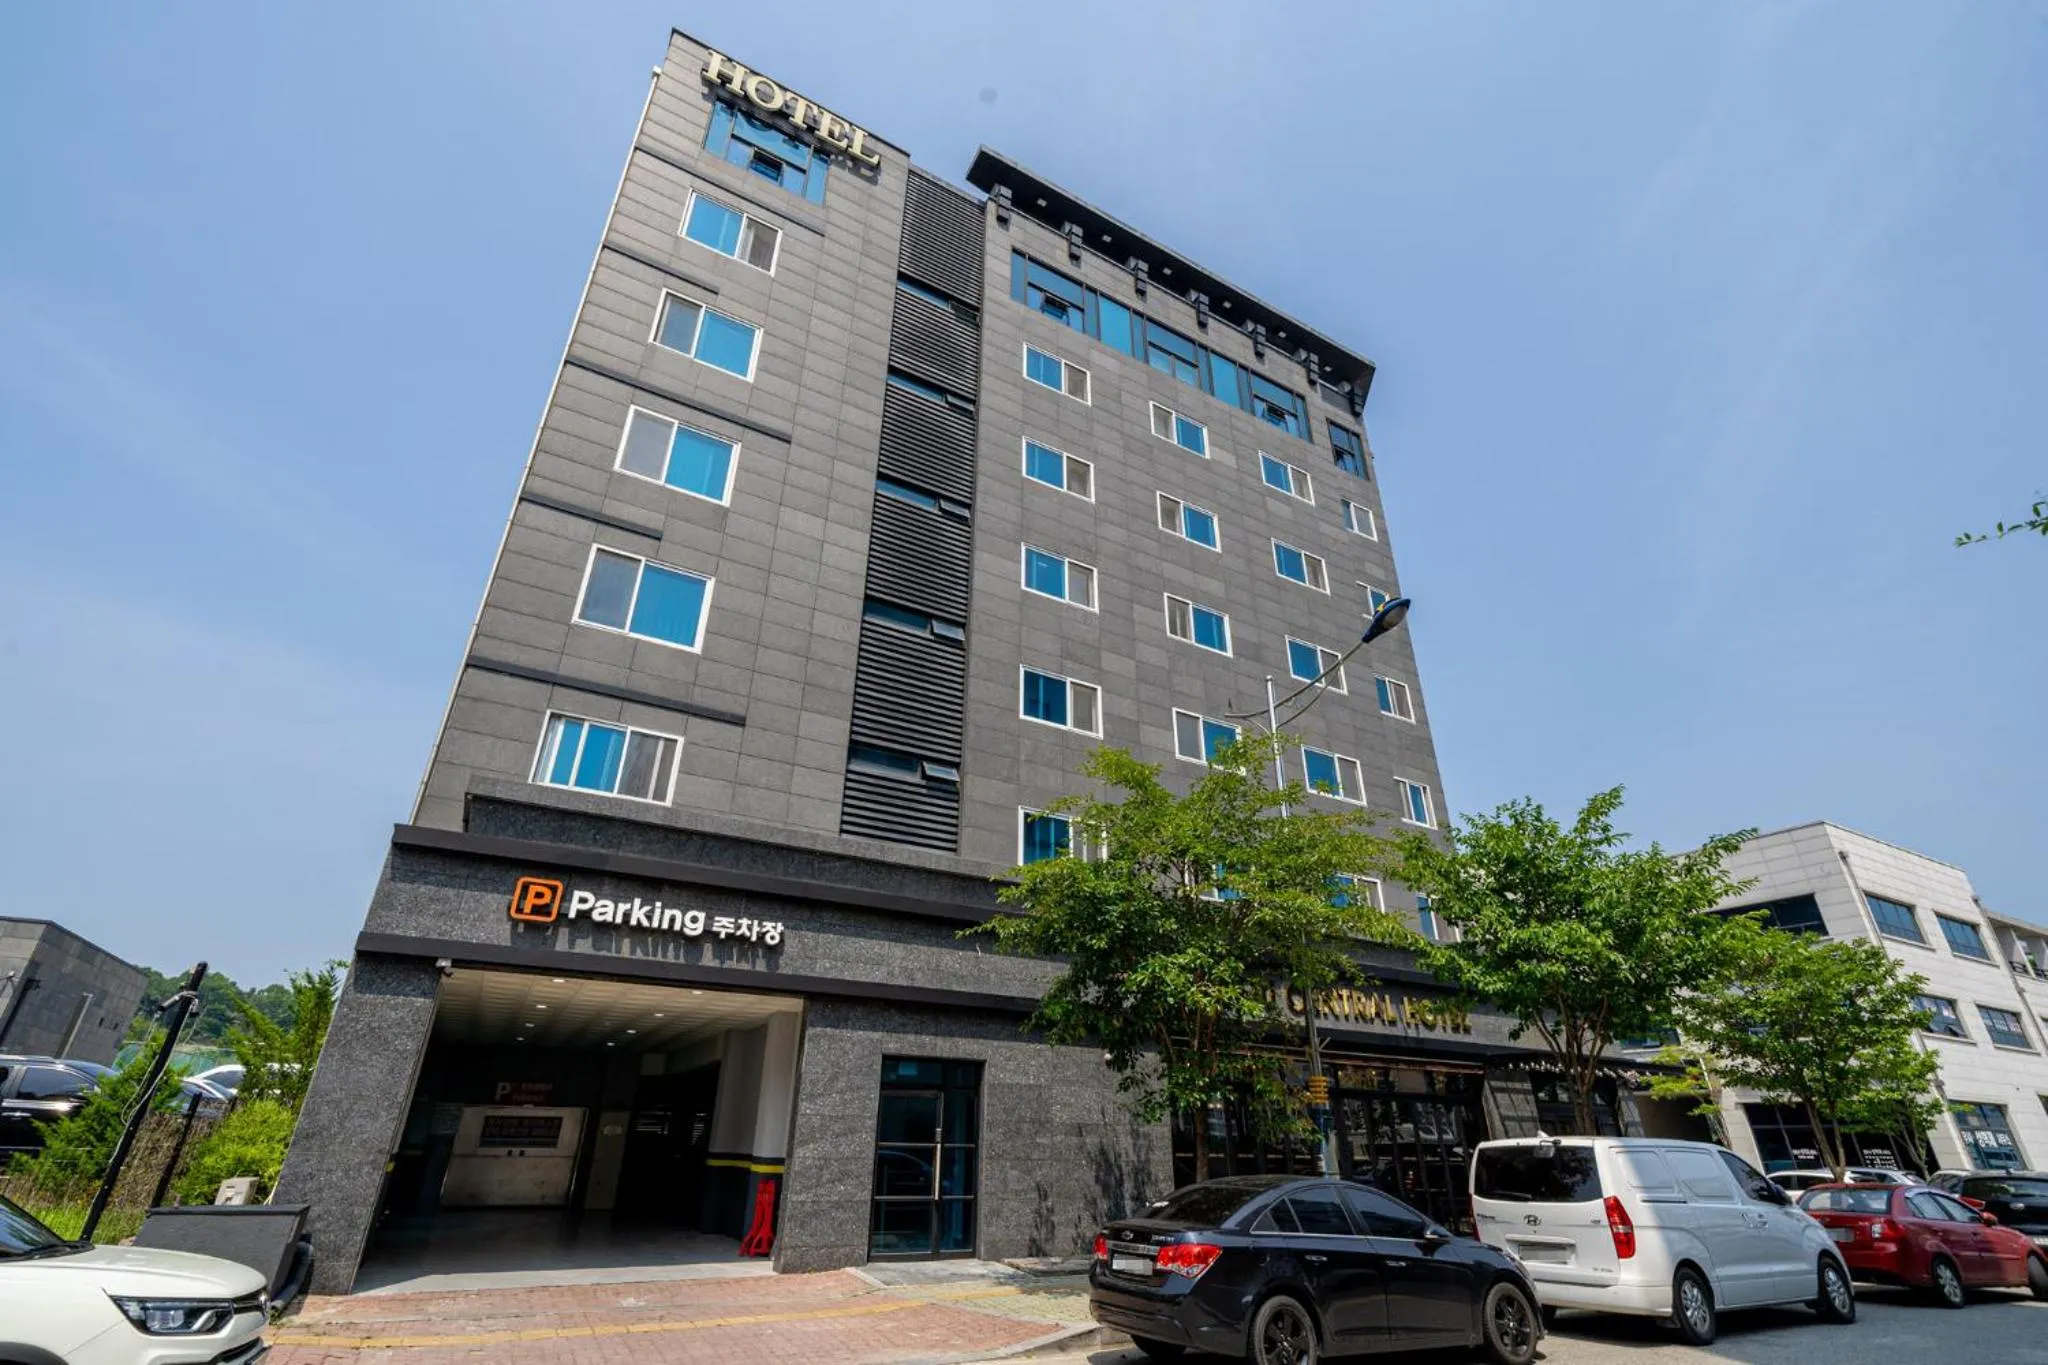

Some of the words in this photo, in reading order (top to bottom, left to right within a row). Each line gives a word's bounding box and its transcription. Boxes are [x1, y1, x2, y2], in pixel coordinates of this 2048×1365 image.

[702, 51, 880, 166] HOTEL
[567, 890, 706, 935] Parking
[712, 916, 784, 946] 주차장
